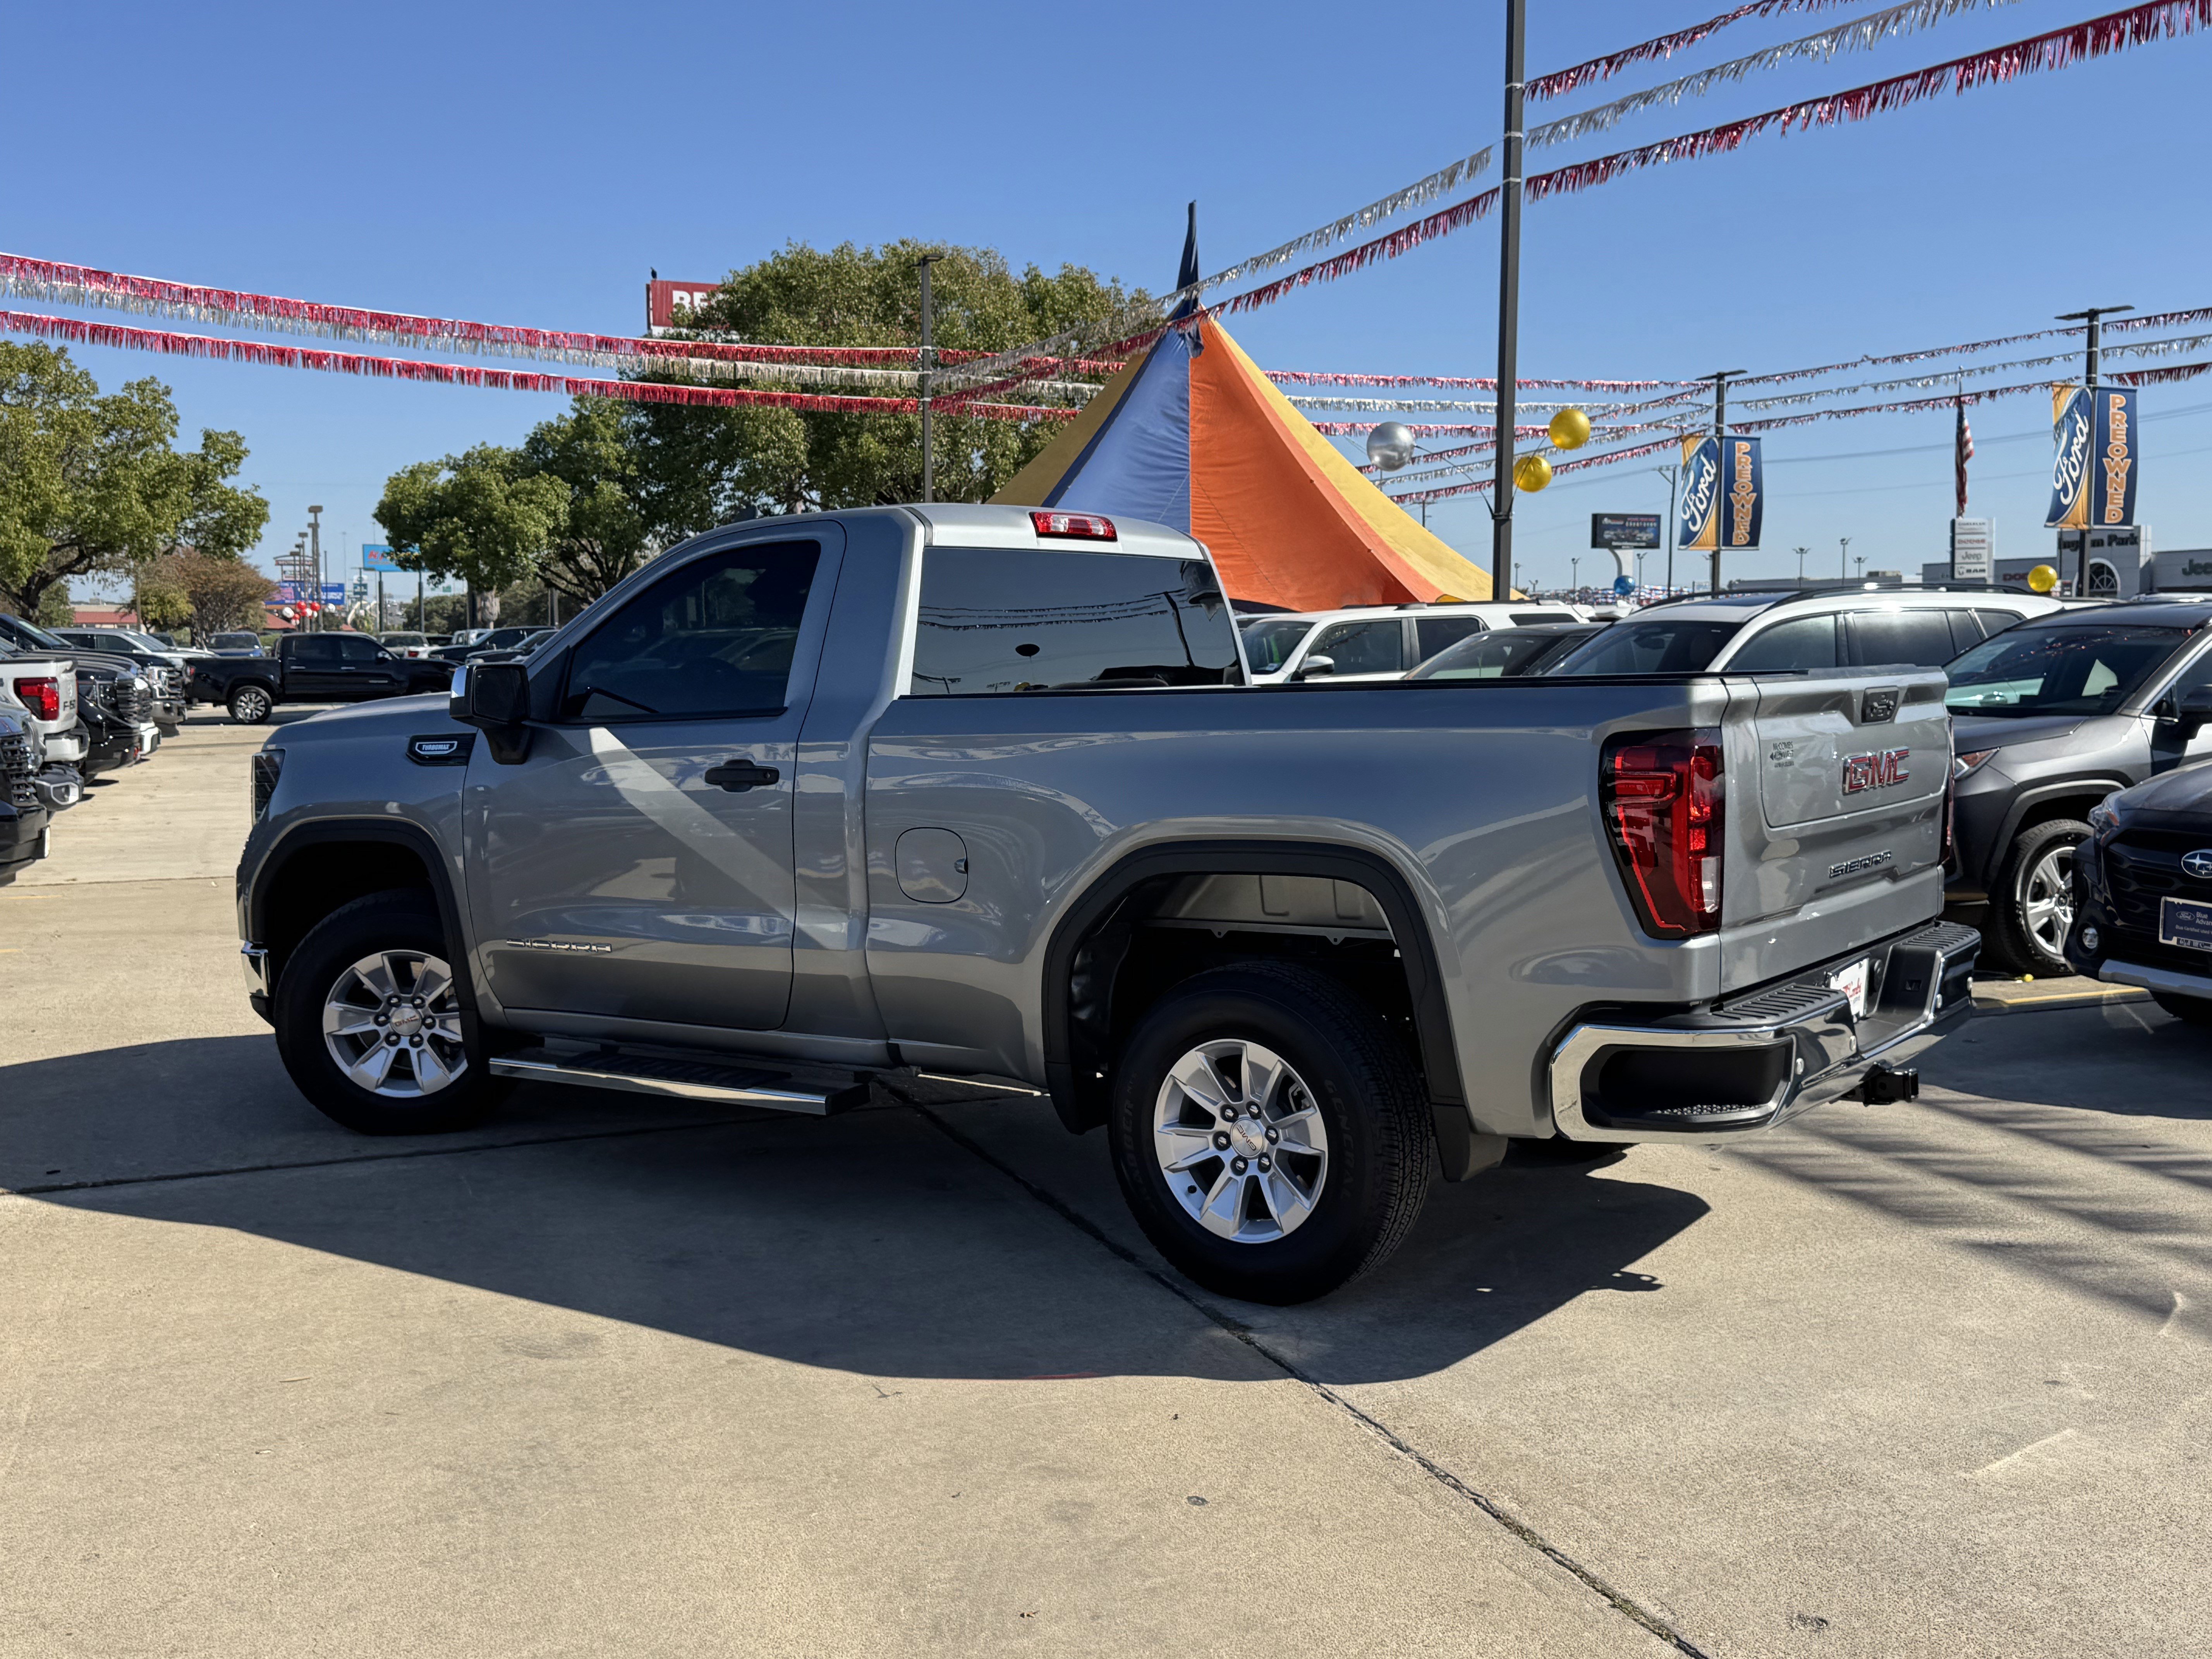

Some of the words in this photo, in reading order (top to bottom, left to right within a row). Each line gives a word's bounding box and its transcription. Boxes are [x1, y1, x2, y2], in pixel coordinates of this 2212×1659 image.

[2054, 407, 2089, 505] Ford
[2102, 394, 2132, 524] PREOWNED
[1681, 452, 1716, 532] Ford
[1729, 441, 1757, 546] PREOWNED
[1961, 551, 1982, 560] Jeep
[1842, 745, 1910, 796] GMC
[1828, 849, 1891, 879] SIERRA
[2195, 918, 2212, 926] Advan
[395, 1015, 419, 1027] GMC
[1237, 1124, 1257, 1151] GMC
